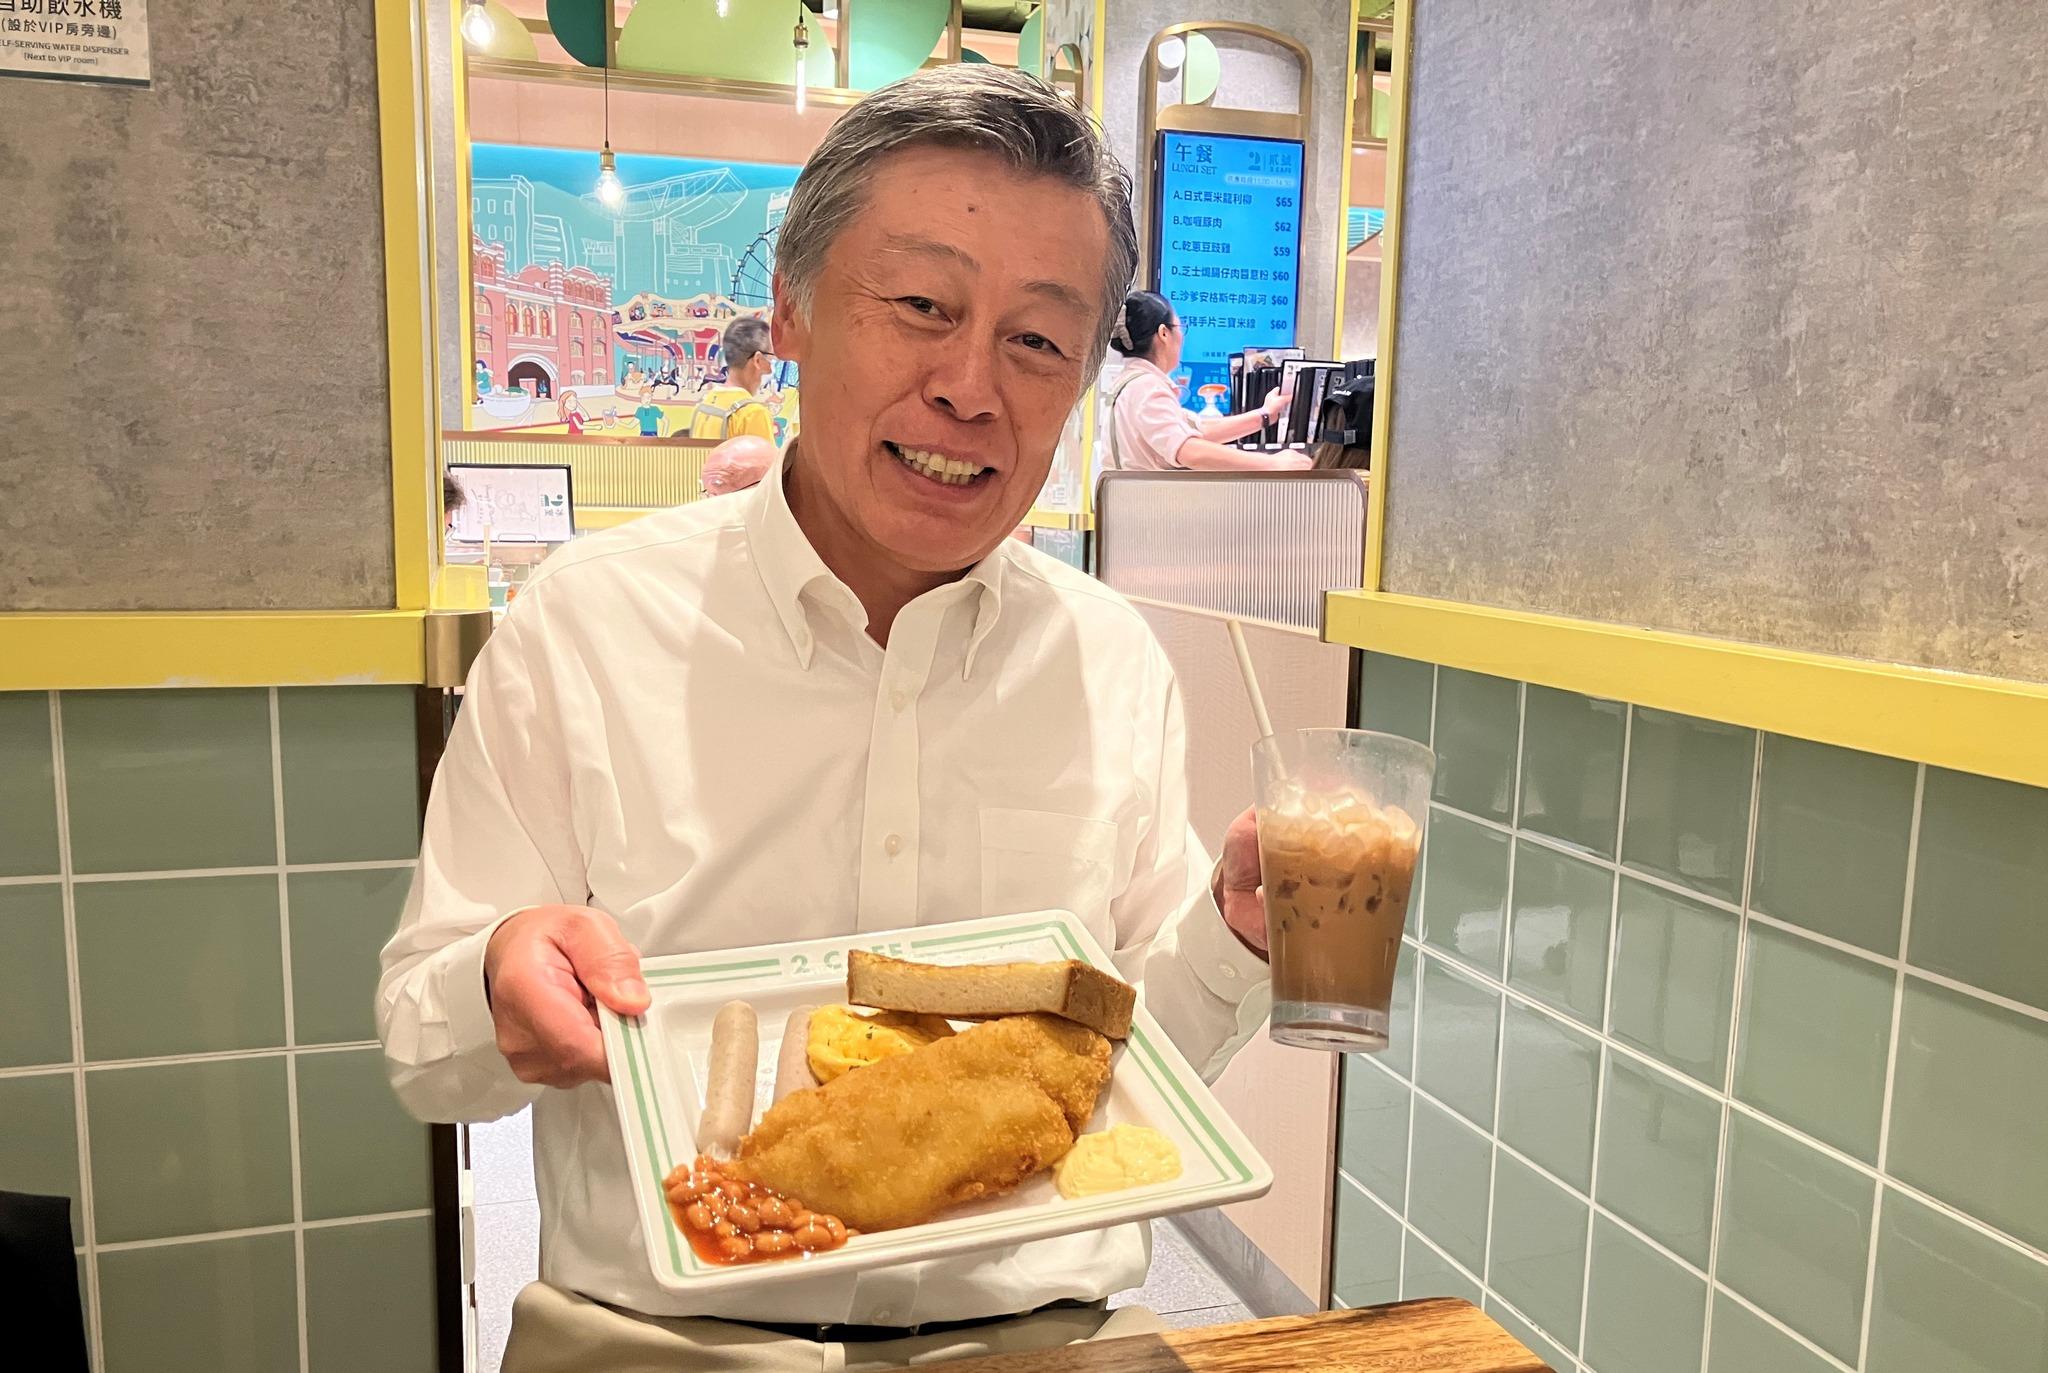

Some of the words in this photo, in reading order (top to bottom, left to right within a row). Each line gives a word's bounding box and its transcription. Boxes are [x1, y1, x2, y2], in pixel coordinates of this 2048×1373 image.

[1, 18, 117, 40] (設於VIP房旁邊)
[53, 43, 80, 52] WATER
[83, 45, 129, 55] DISPENSER
[24, 52, 46, 61] (Next
[58, 55, 72, 63] VIP
[1175, 143, 1212, 164] 午餐
[1171, 163, 1199, 174] LUNCH
[1201, 165, 1217, 175] SET
[1276, 196, 1293, 208] $65
[1275, 221, 1291, 232] $62
[1273, 246, 1291, 257] $59
[1272, 271, 1289, 281] $60
[1271, 296, 1288, 306] $60
[1270, 320, 1287, 330] $60
[791, 954, 810, 974] 2
[823, 943, 903, 970] CFE
